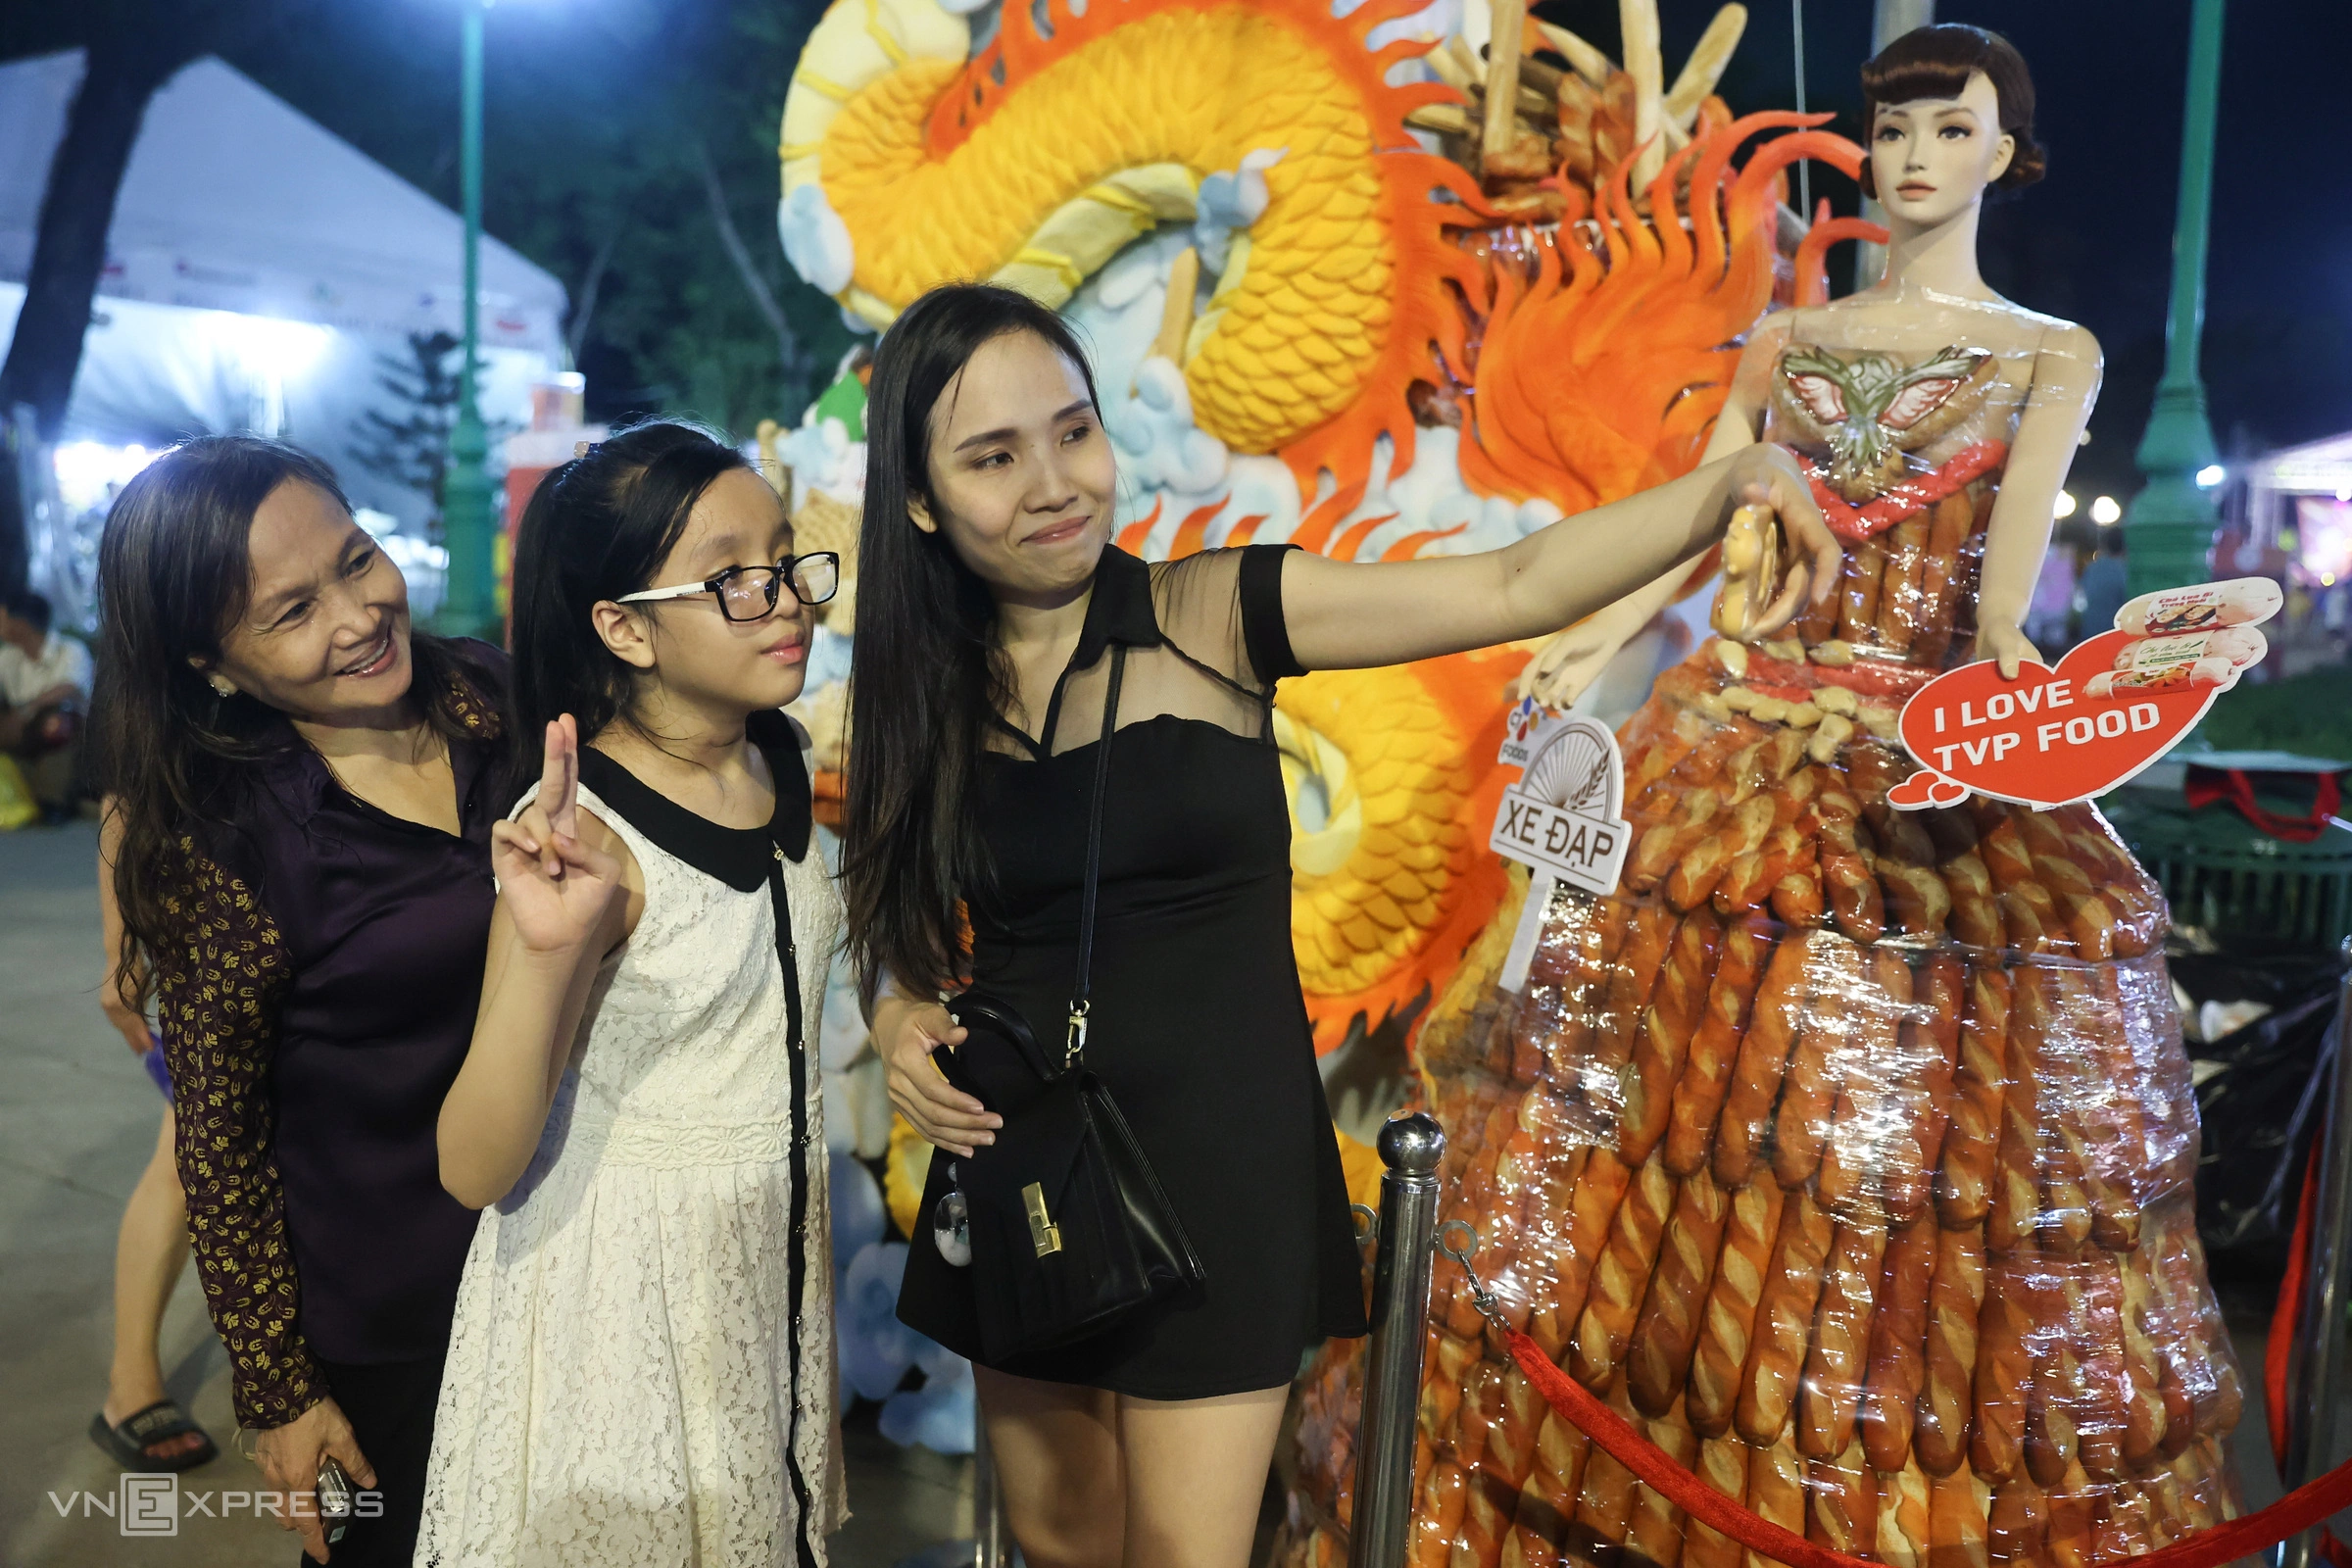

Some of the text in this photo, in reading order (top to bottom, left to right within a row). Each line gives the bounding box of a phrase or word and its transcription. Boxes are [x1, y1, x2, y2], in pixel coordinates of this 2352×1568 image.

[1933, 703, 2160, 772] TVP FOOD
[1935, 679, 2074, 733] I LOVE
[1500, 800, 1613, 867] XE ĐẠP
